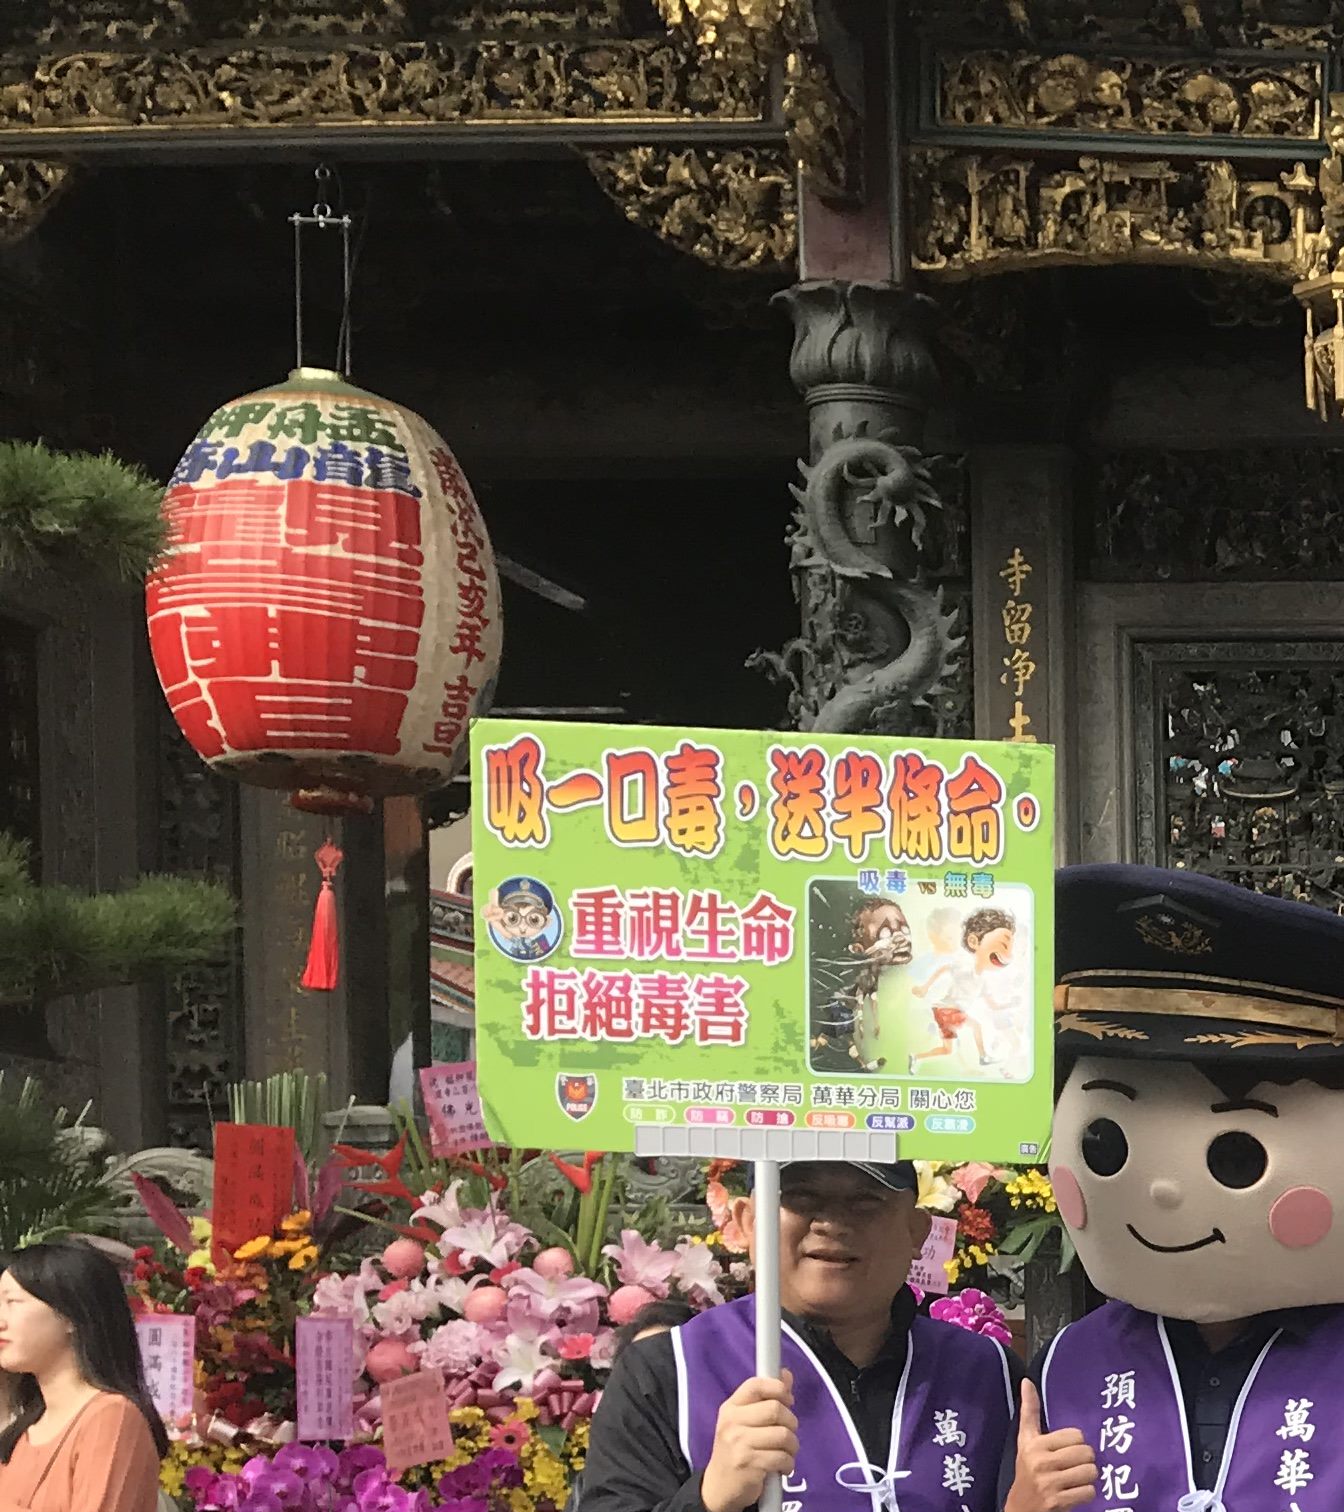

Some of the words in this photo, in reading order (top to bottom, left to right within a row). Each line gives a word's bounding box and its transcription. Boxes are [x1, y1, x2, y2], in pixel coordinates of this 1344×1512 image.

[486, 737, 1036, 864] 吸一口毒，送半條命。
[859, 870, 907, 893] 吸毒
[944, 871, 994, 898] 無毒
[570, 889, 795, 963] 重視生命
[525, 970, 747, 1045] 拒絕毒害
[624, 1079, 802, 1105] 臺北市政府警察局
[812, 1086, 899, 1109] 萬華分局
[910, 1089, 975, 1110] 關心您
